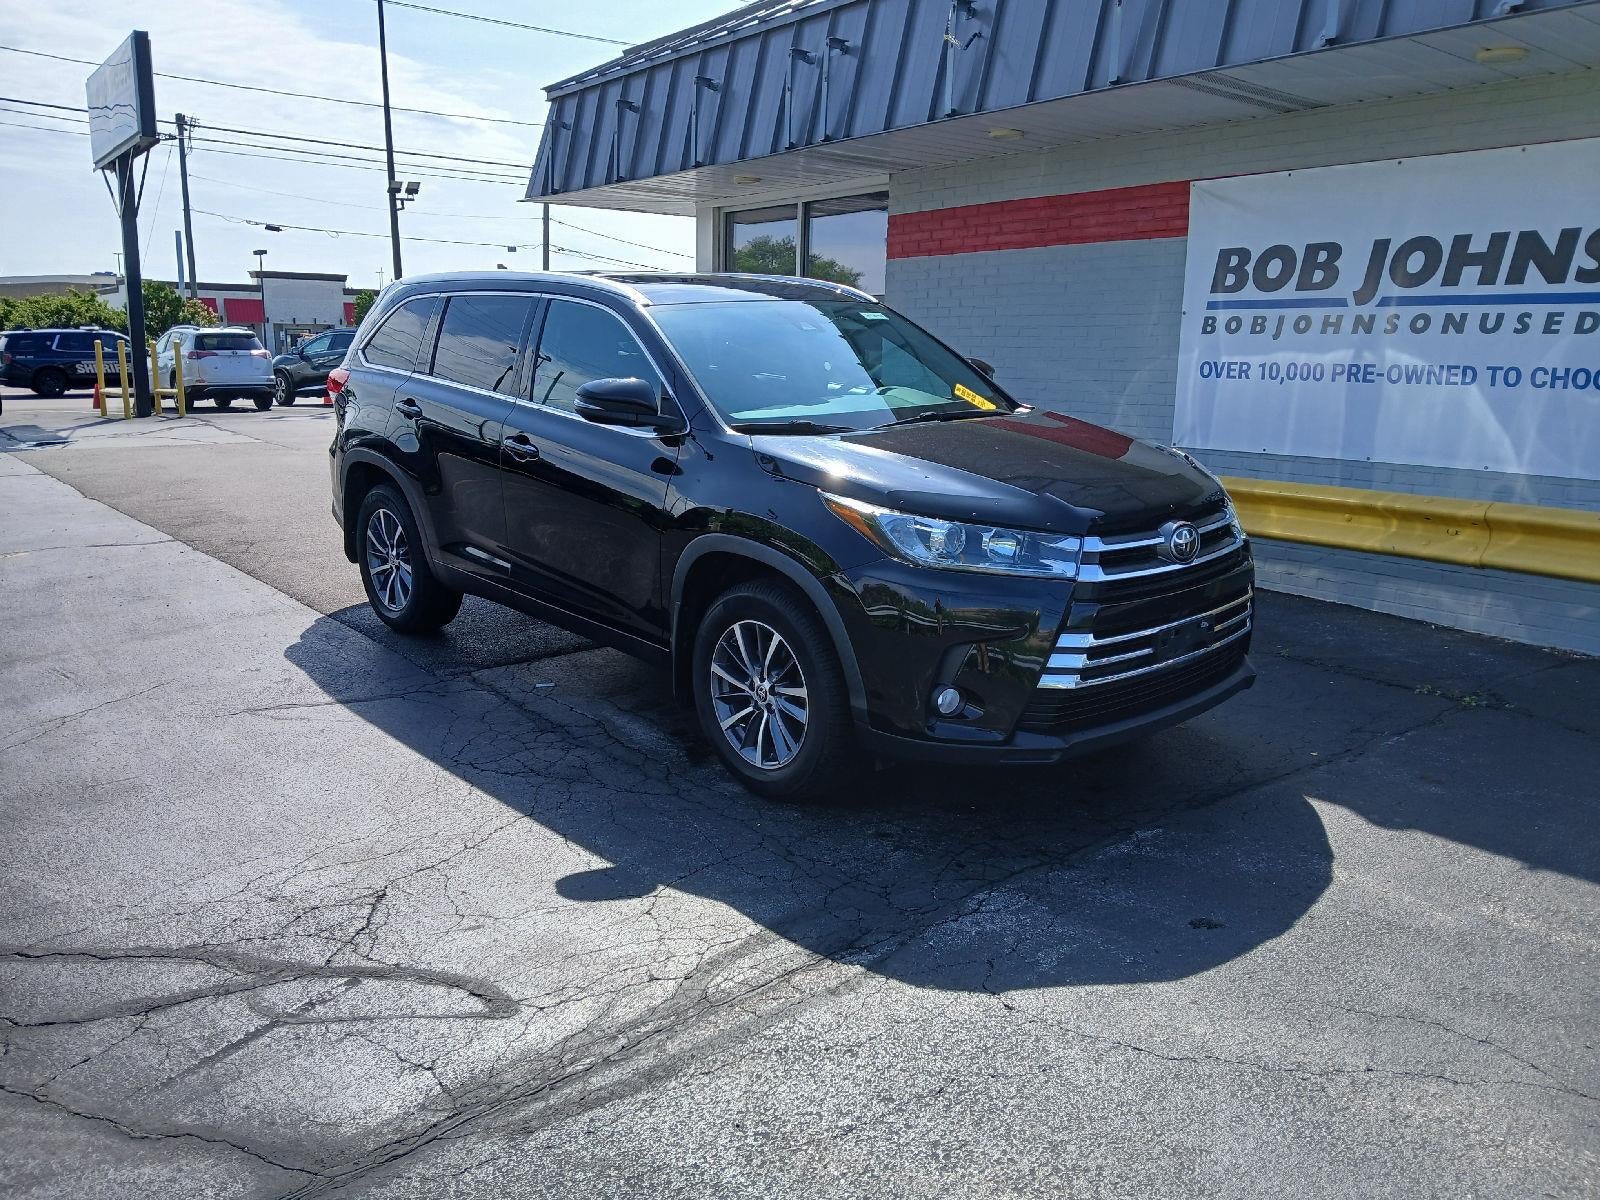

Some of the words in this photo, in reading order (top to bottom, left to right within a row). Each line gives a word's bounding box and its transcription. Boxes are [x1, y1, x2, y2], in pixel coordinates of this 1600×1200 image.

[1210, 241, 1343, 294] BOB
[1200, 360, 1251, 380] OVER
[1258, 361, 1325, 384] 10,000
[1331, 363, 1478, 386] PRE-OWNED
[1486, 366, 1522, 388] TO
